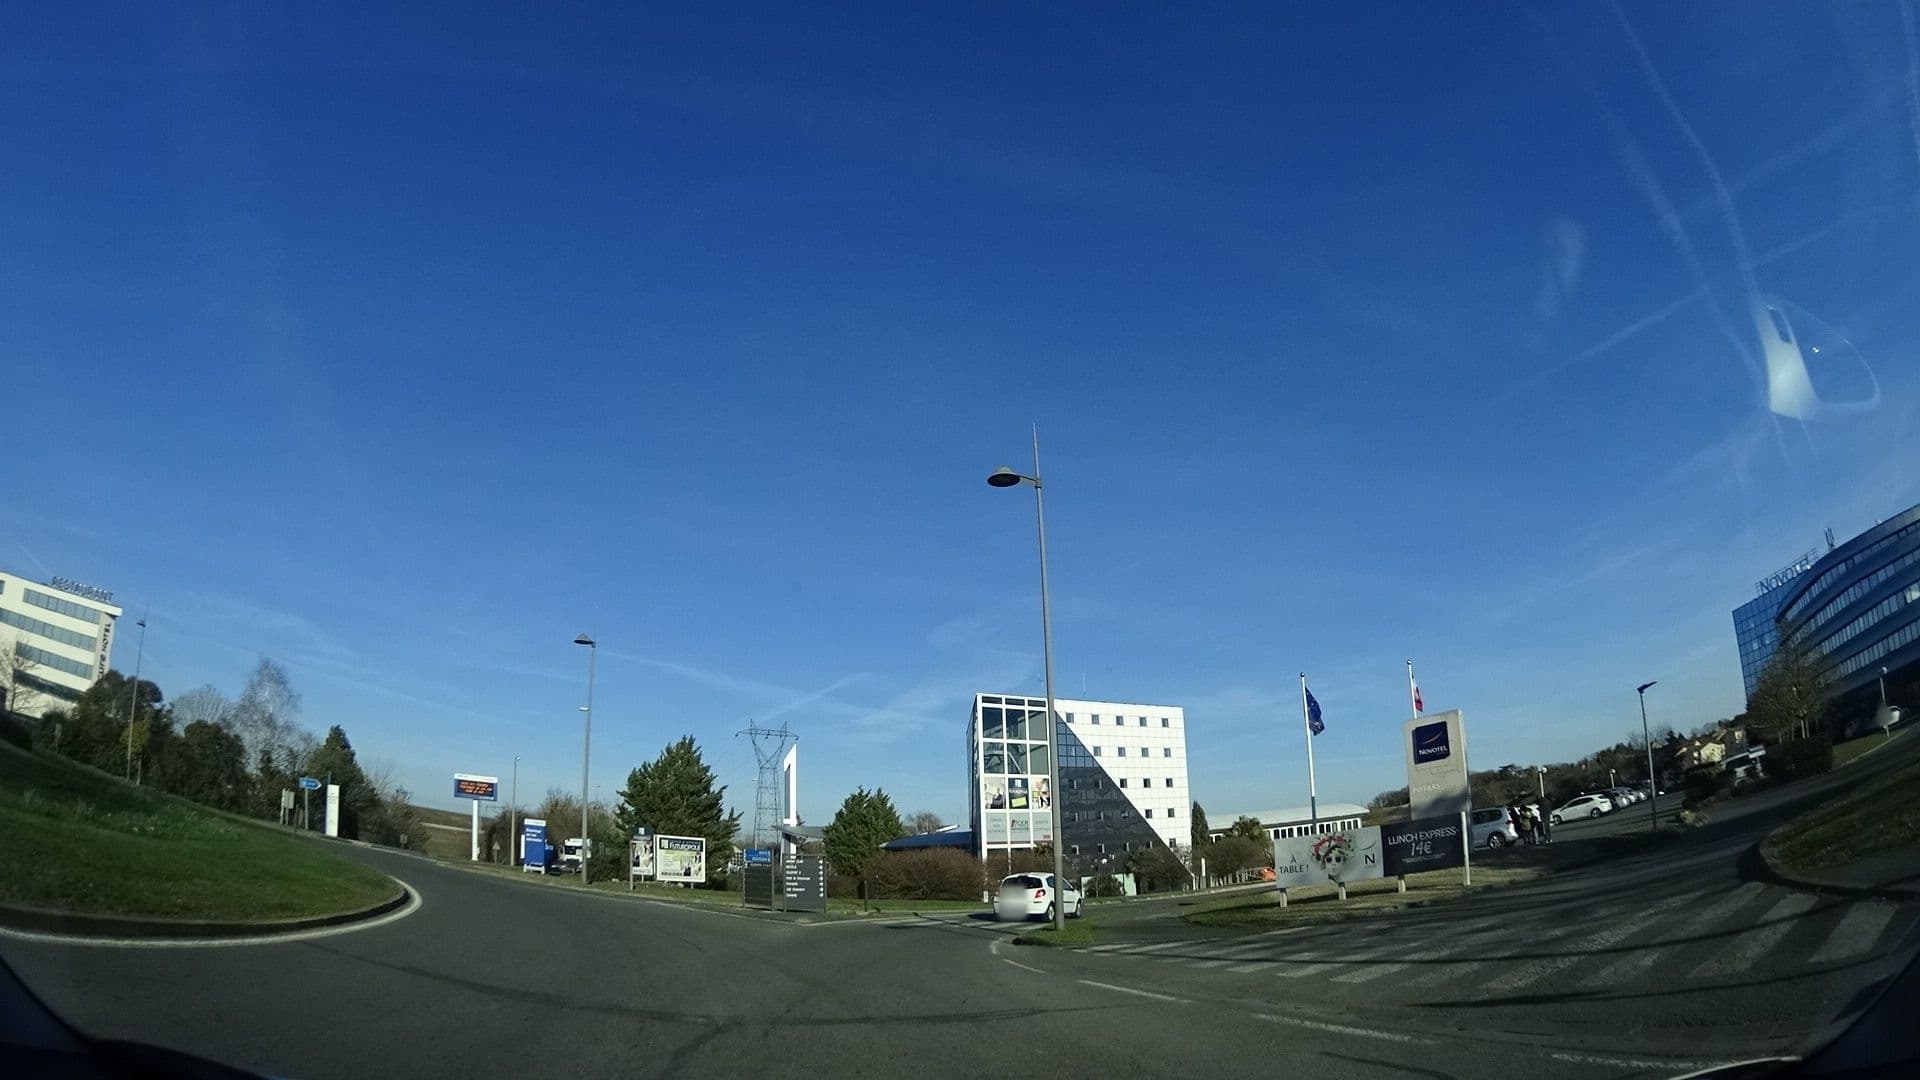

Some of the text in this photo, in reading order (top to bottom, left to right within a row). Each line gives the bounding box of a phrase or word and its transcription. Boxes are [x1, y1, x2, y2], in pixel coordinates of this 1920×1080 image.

[1418, 745, 1448, 756] NOVOTEL
[1388, 826, 1457, 846] LUNCH EXPRESS
[1410, 841, 1433, 856] 14€
[1364, 853, 1375, 864] N
